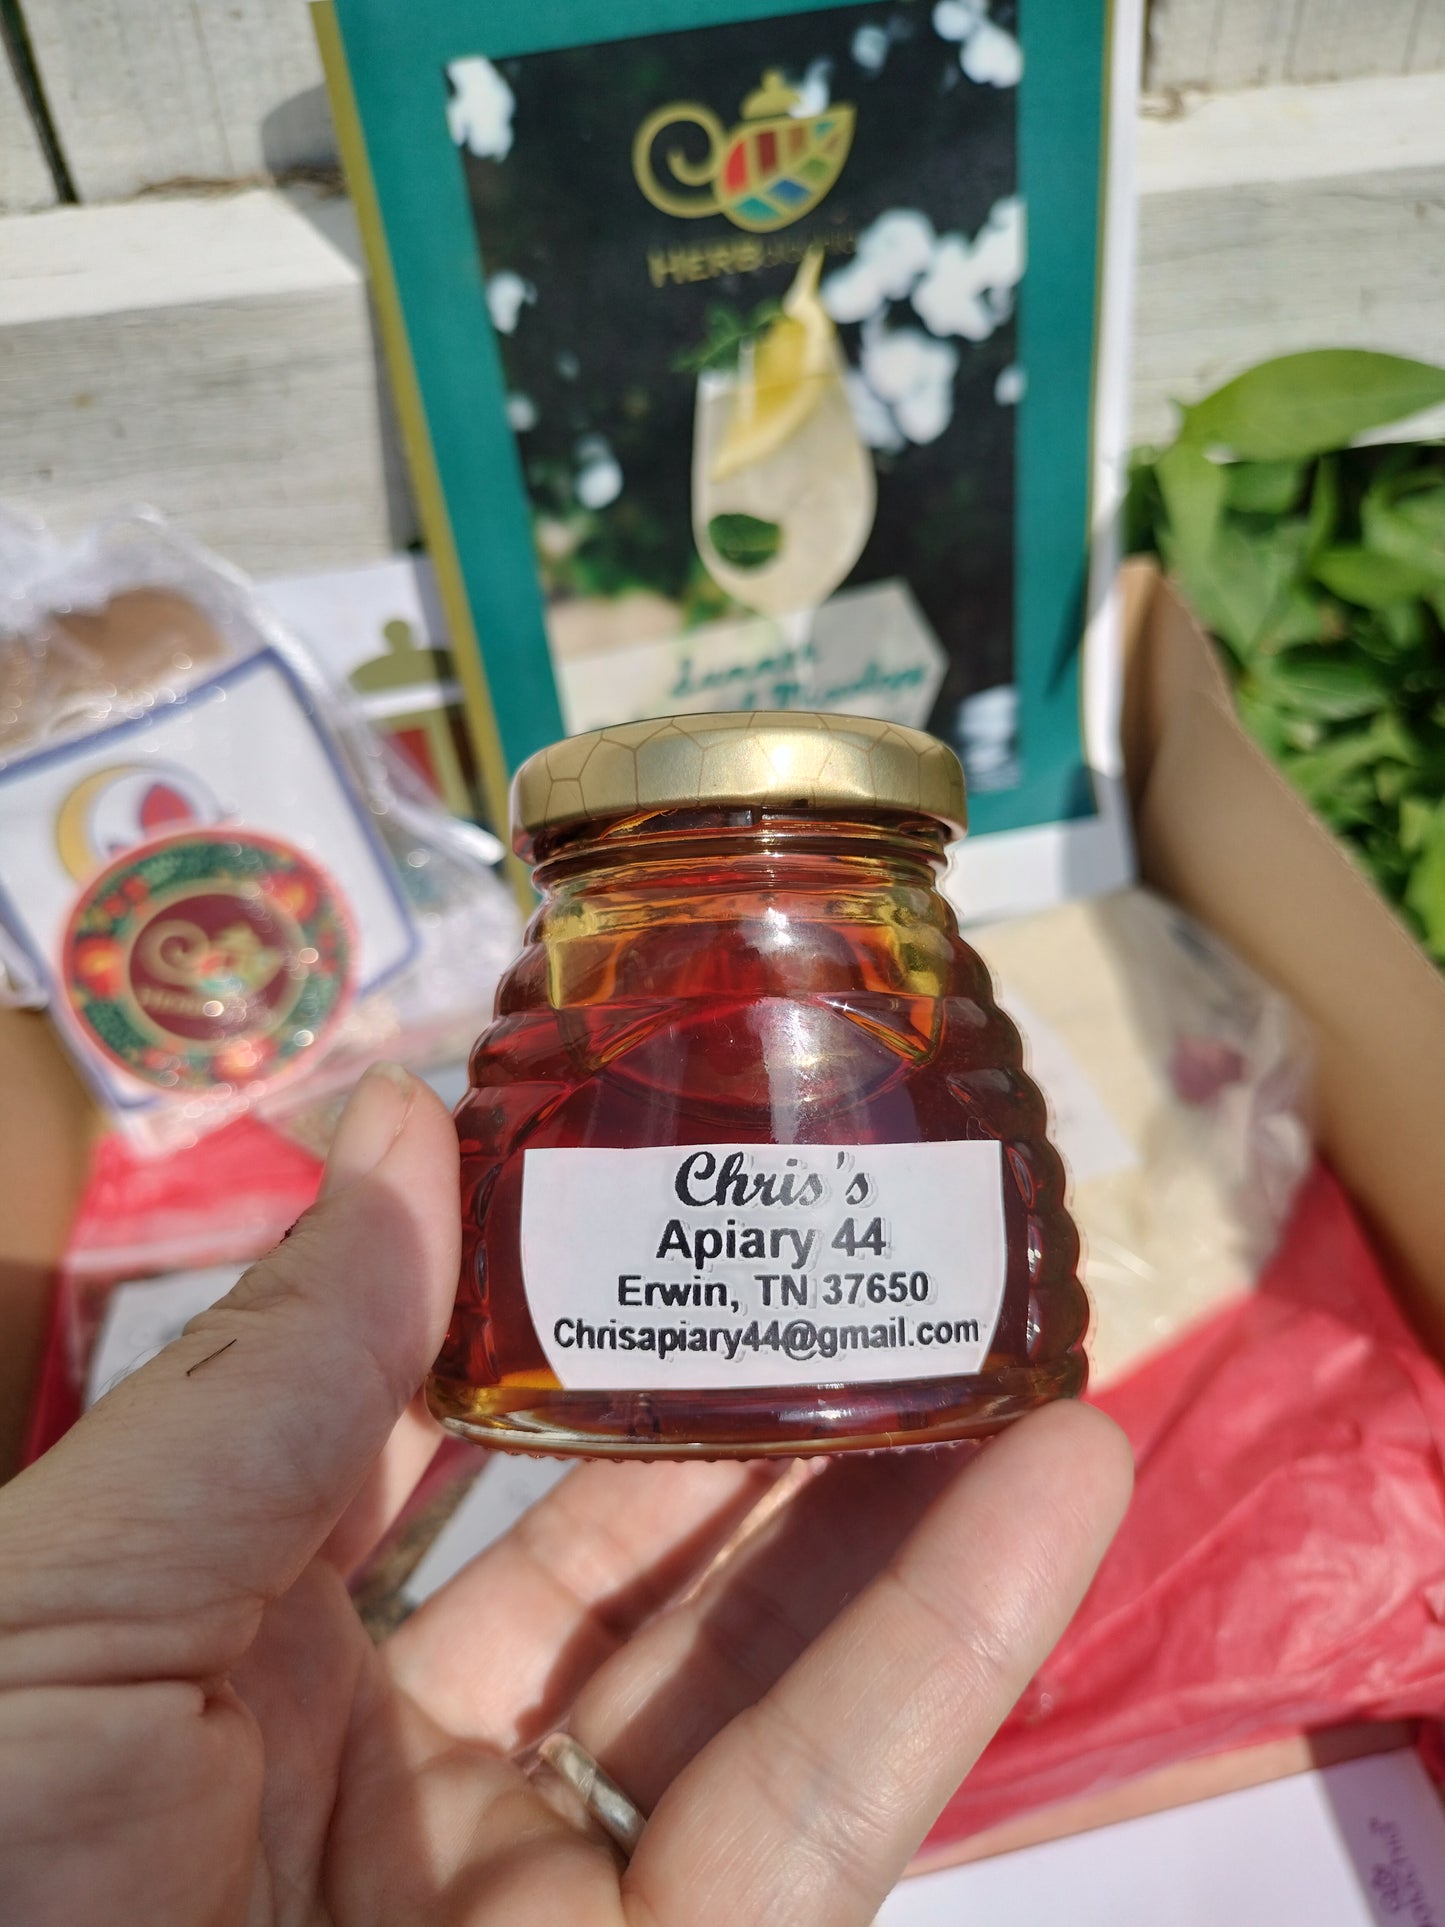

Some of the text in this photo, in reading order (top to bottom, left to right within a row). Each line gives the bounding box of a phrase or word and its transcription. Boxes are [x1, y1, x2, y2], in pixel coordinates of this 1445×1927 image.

[674, 1151, 872, 1207] Chris's
[656, 1217, 887, 1269] Apiary 44
[617, 1270, 930, 1312] Erwin, TN 37650
[553, 1317, 980, 1360] Chrisapiary44@gmail.com
